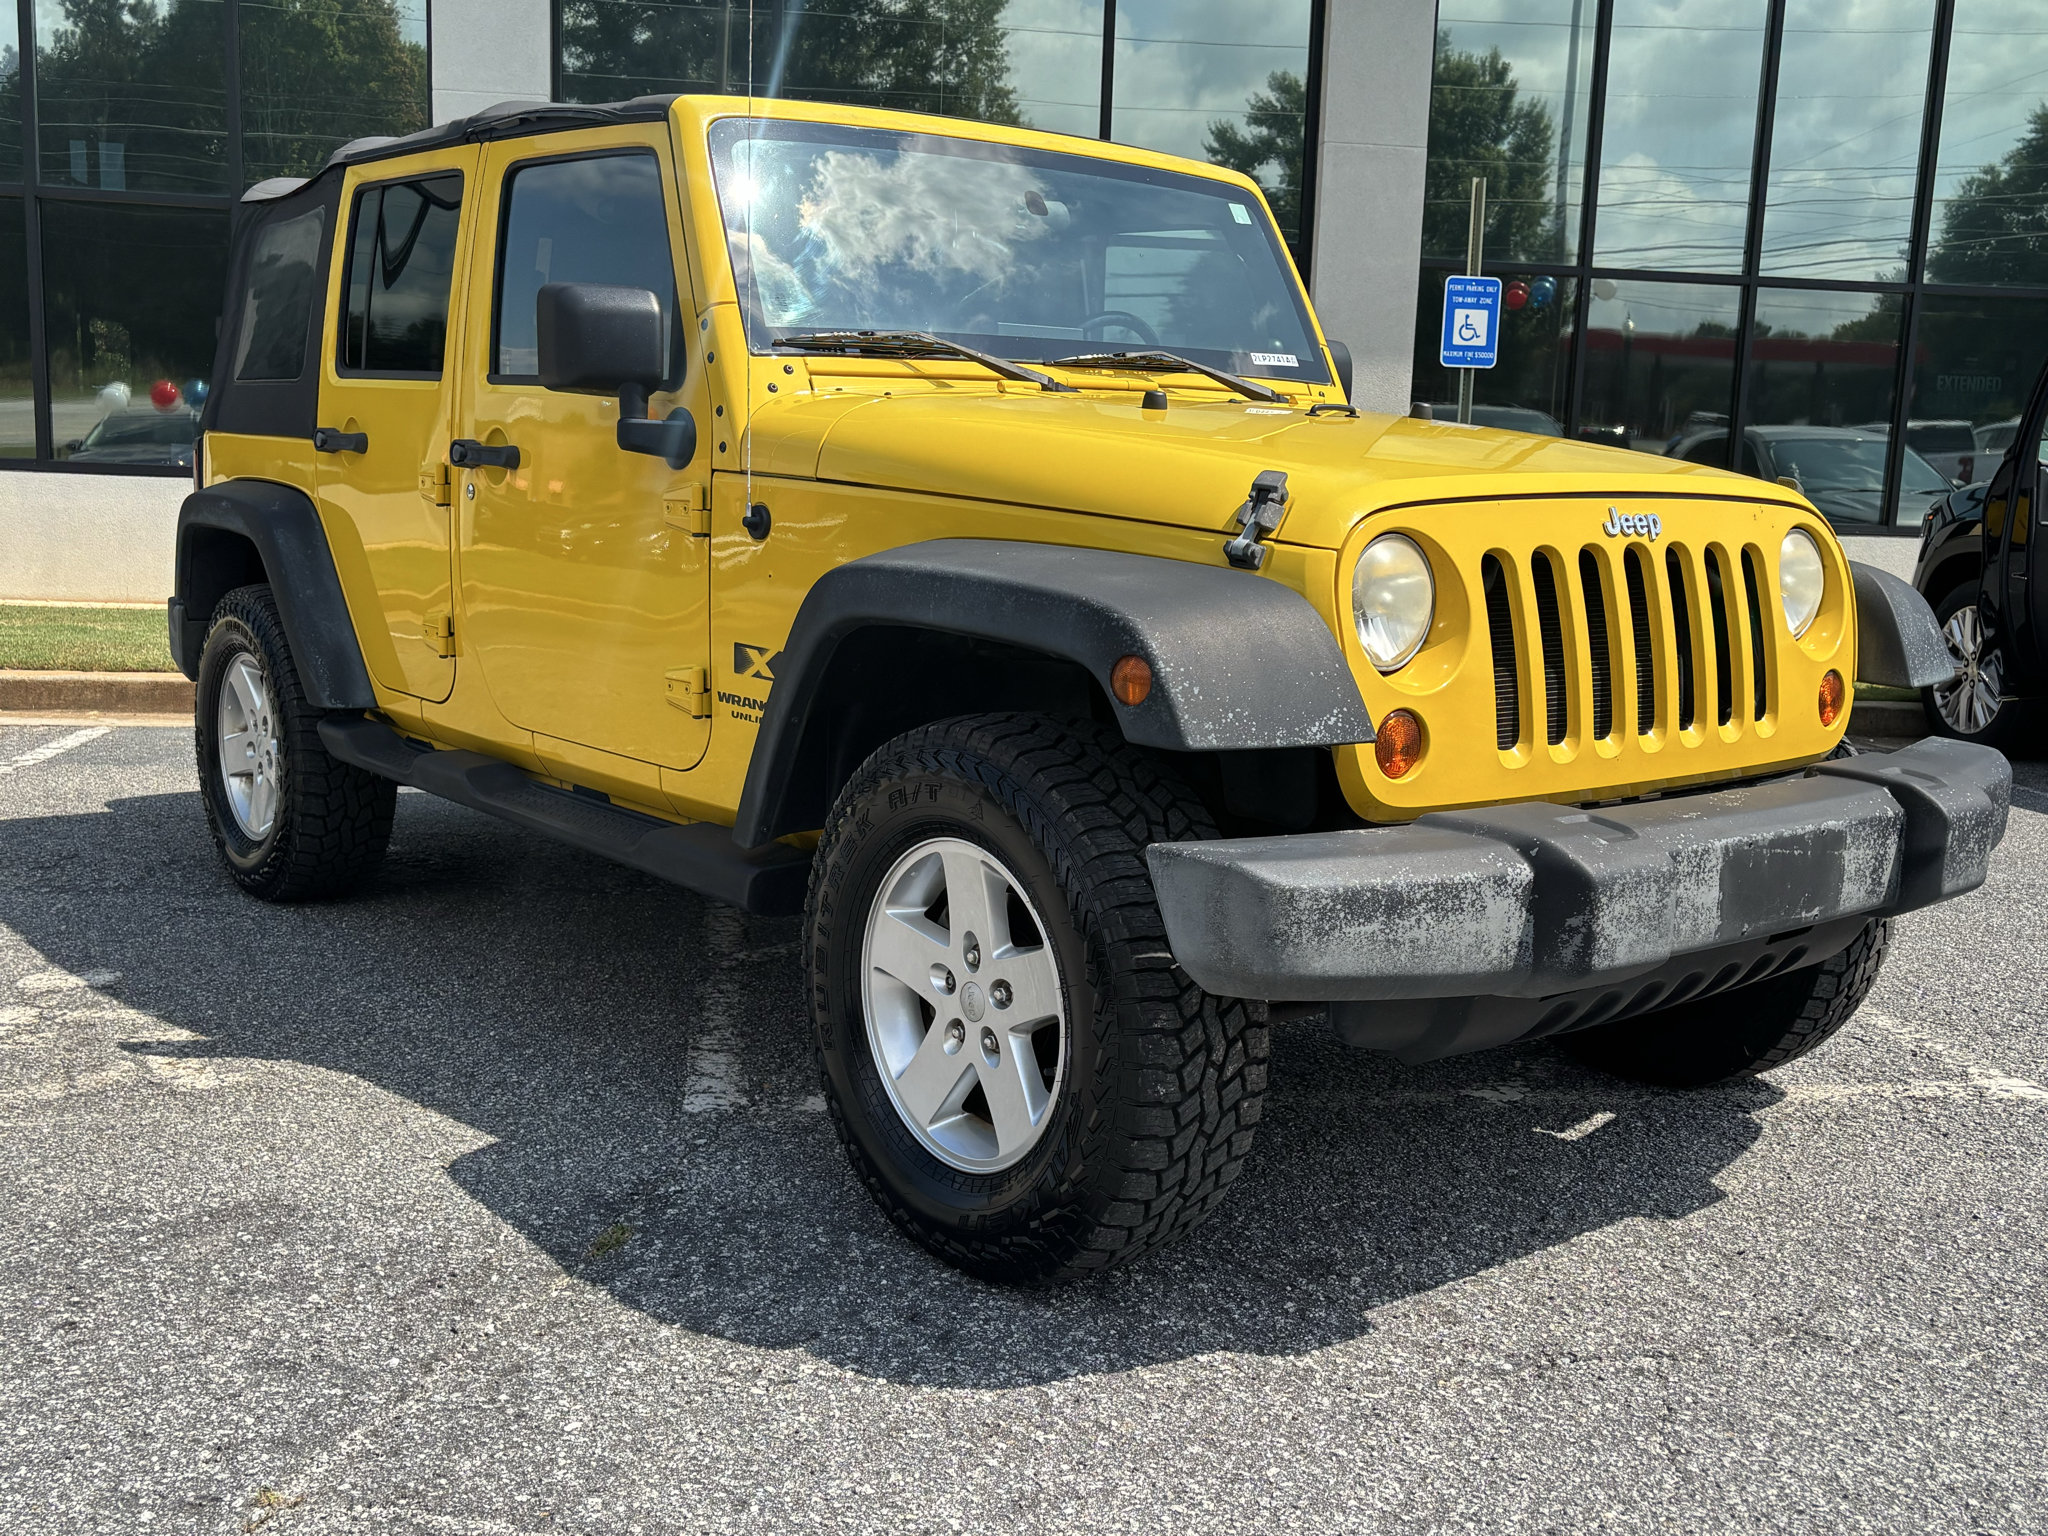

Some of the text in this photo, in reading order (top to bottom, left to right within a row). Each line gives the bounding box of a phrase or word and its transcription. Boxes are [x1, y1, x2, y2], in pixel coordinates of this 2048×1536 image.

[1452, 296, 1477, 304] TOW-AWAY
[1443, 350, 1463, 358] MAXIMUM
[1936, 374, 2003, 393] EXTENDED
[1602, 506, 1662, 542] Jeep
[739, 645, 779, 680] X
[717, 691, 767, 712] WRAN
[731, 710, 763, 724] UNLI
